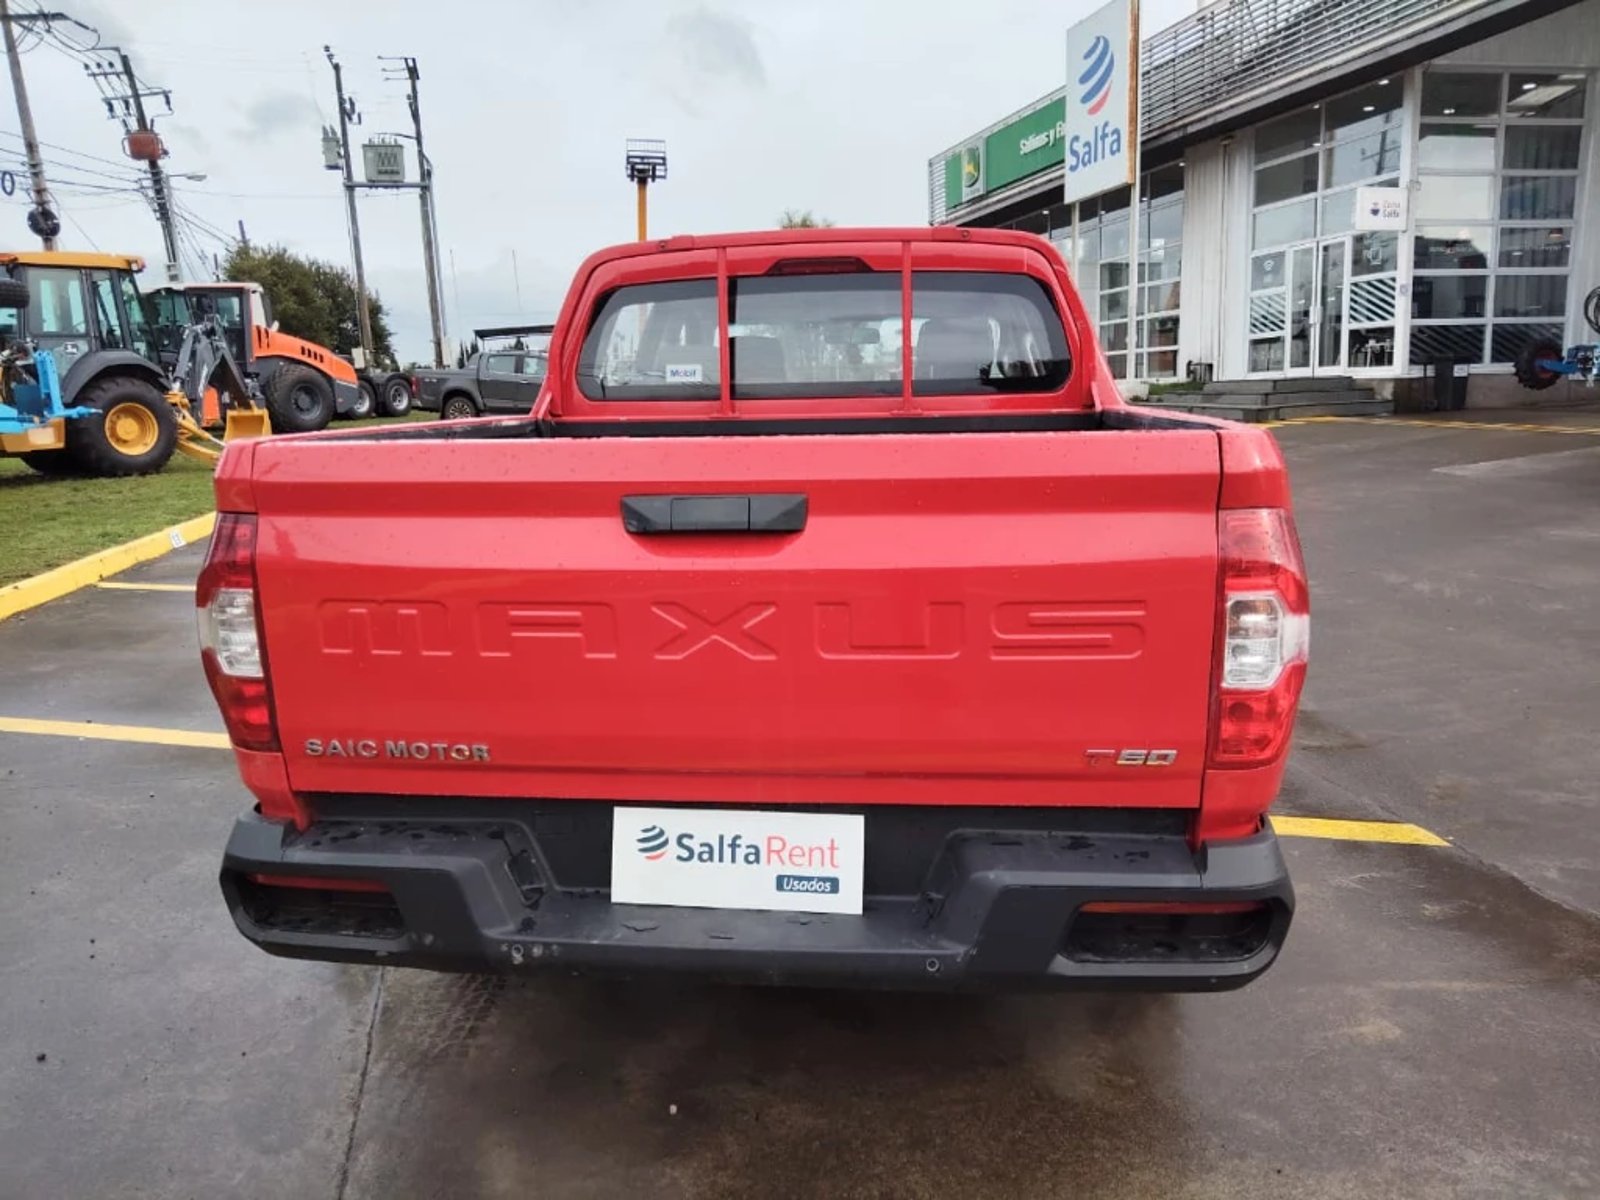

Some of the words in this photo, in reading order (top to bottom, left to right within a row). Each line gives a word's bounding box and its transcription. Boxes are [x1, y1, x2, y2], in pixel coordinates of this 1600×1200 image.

[1069, 120, 1121, 172] Salfa
[317, 598, 1147, 662] MAXUS
[305, 738, 378, 758] SAIC
[385, 740, 490, 761] MOTOR
[1085, 748, 1177, 766] T60
[783, 877, 832, 893] Usados
